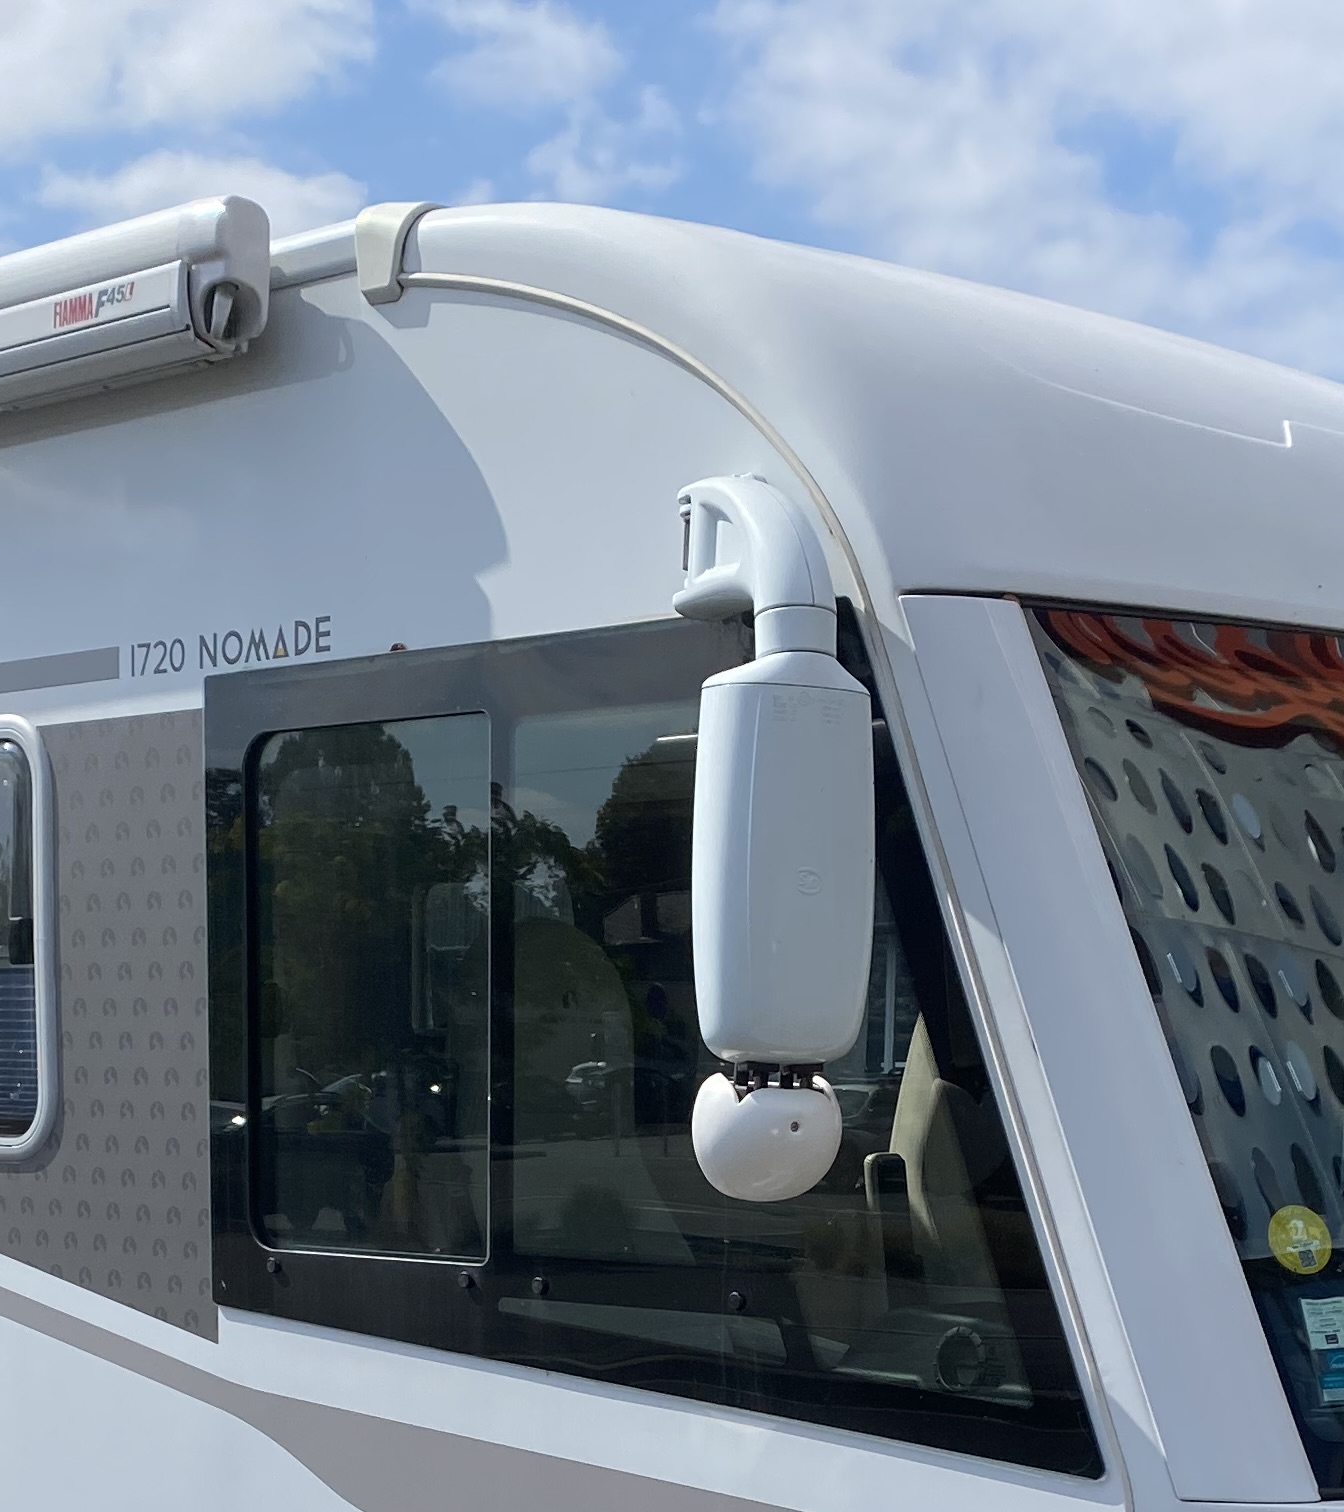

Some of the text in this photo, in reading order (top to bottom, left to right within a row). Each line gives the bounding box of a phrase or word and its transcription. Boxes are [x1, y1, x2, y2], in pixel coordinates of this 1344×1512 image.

[53, 292, 94, 329] FIAMMA
[130, 615, 332, 678] 1720 NOMADE
